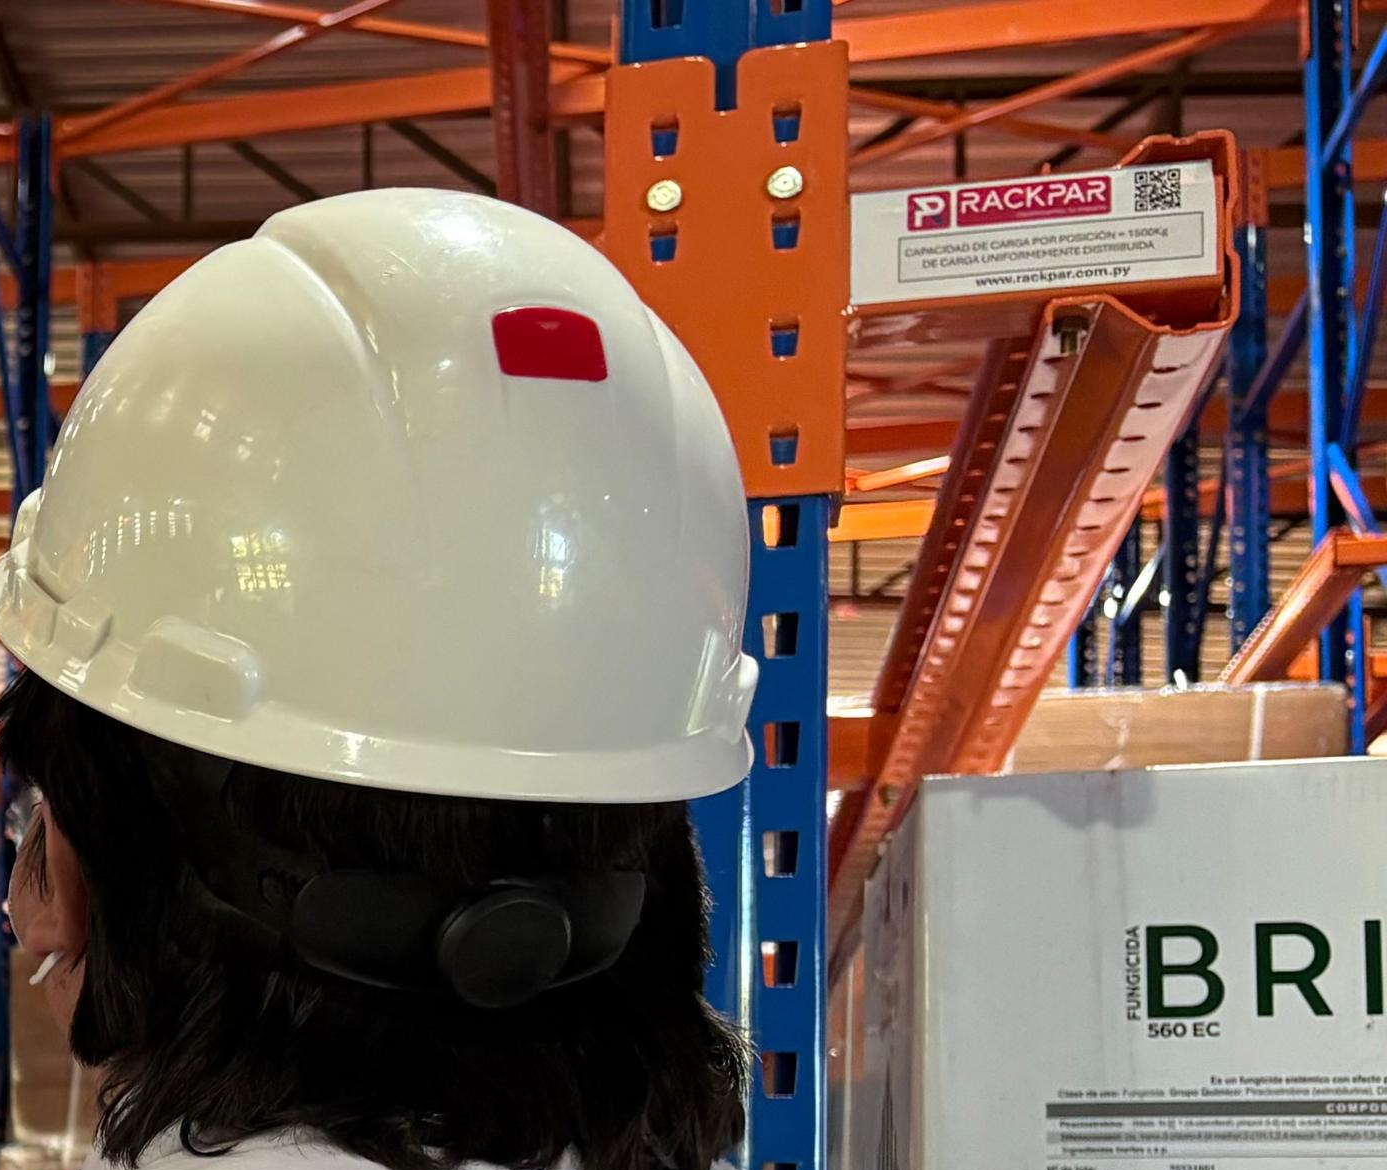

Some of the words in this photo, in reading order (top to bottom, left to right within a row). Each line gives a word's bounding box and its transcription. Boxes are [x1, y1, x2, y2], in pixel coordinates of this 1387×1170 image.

[960, 180, 1106, 214] RACKPAR
[904, 243, 970, 257] CAPACIDAD
[972, 241, 988, 252] DE
[990, 238, 1030, 250] CARGA
[1032, 235, 1057, 246] POR
[1059, 229, 1116, 243] POSICIÓN
[922, 258, 938, 268] DE
[940, 255, 980, 267] CARGA
[981, 246, 1082, 263] UNIFORMEMENTE
[1083, 240, 1155, 255] DISTRIBUIDA
[975, 265, 1132, 287] www.rackpar.com.py
[1125, 925, 1141, 1021] FUNGICIDA
[1145, 919, 1384, 1019] BRI
[1147, 1023, 1187, 1039] 560
[1192, 1022, 1221, 1038] EC
